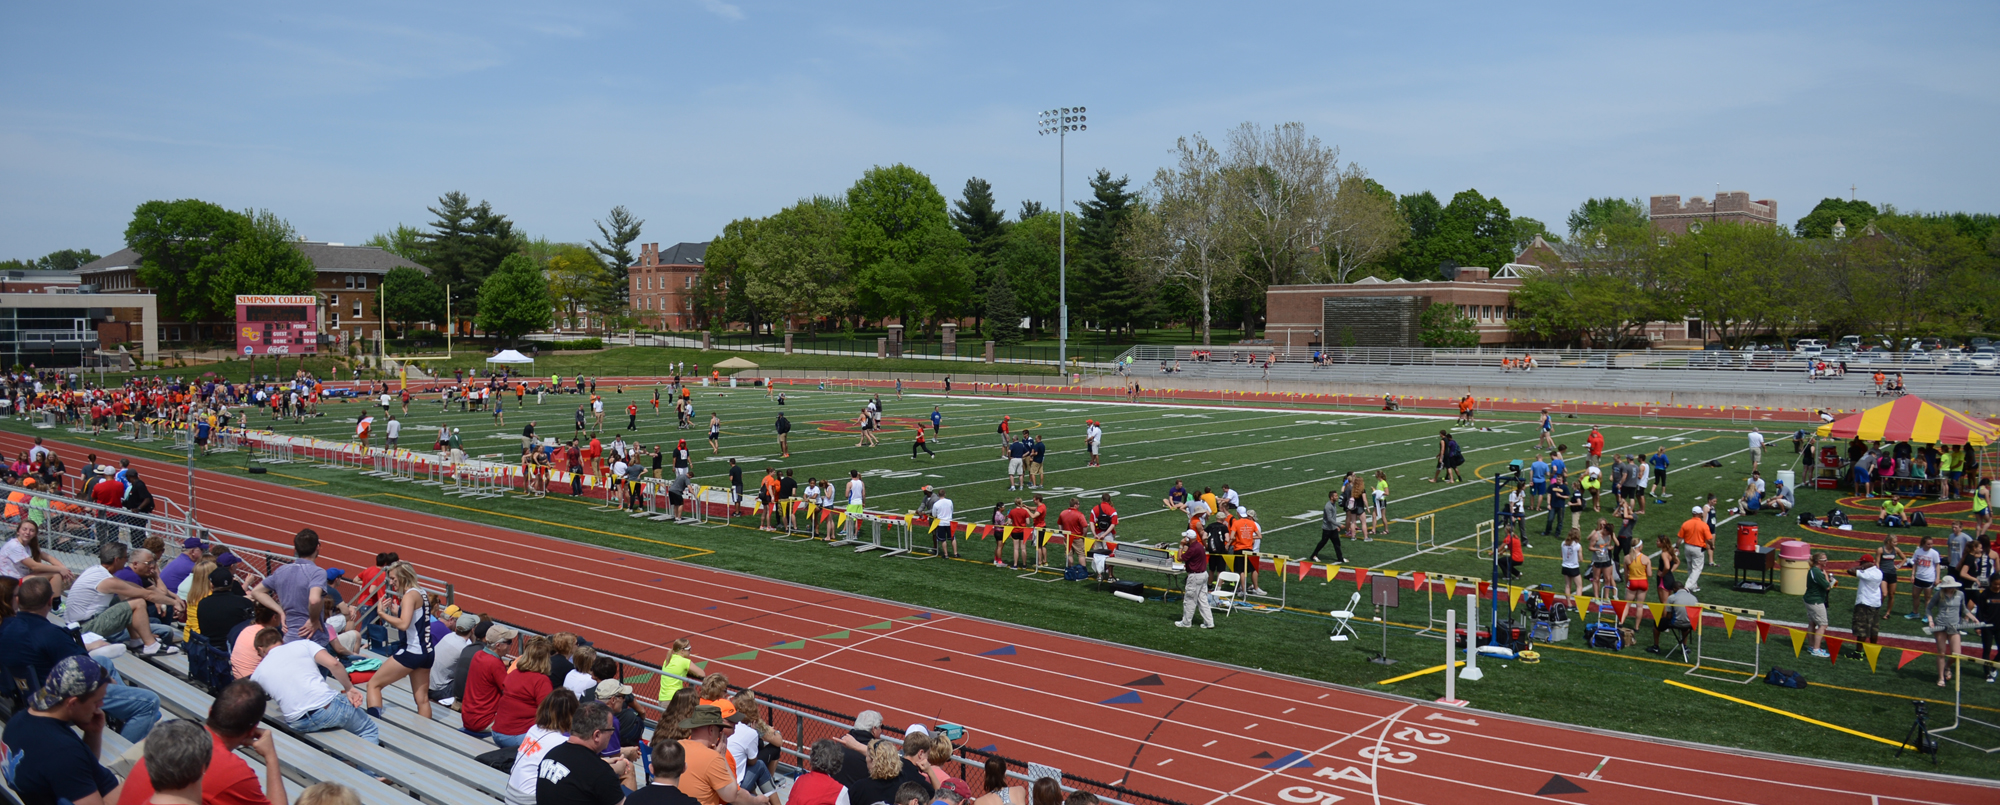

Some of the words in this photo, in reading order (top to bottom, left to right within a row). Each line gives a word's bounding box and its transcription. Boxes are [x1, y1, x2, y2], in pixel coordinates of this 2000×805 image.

[237, 296, 276, 304] SIMPSON
[278, 296, 315, 304] COLLEGE
[1424, 712, 1480, 726] 1
[1393, 727, 1451, 745] 2
[1358, 745, 1418, 764] 3
[1312, 766, 1374, 785] 4
[1277, 786, 1346, 805] 5
